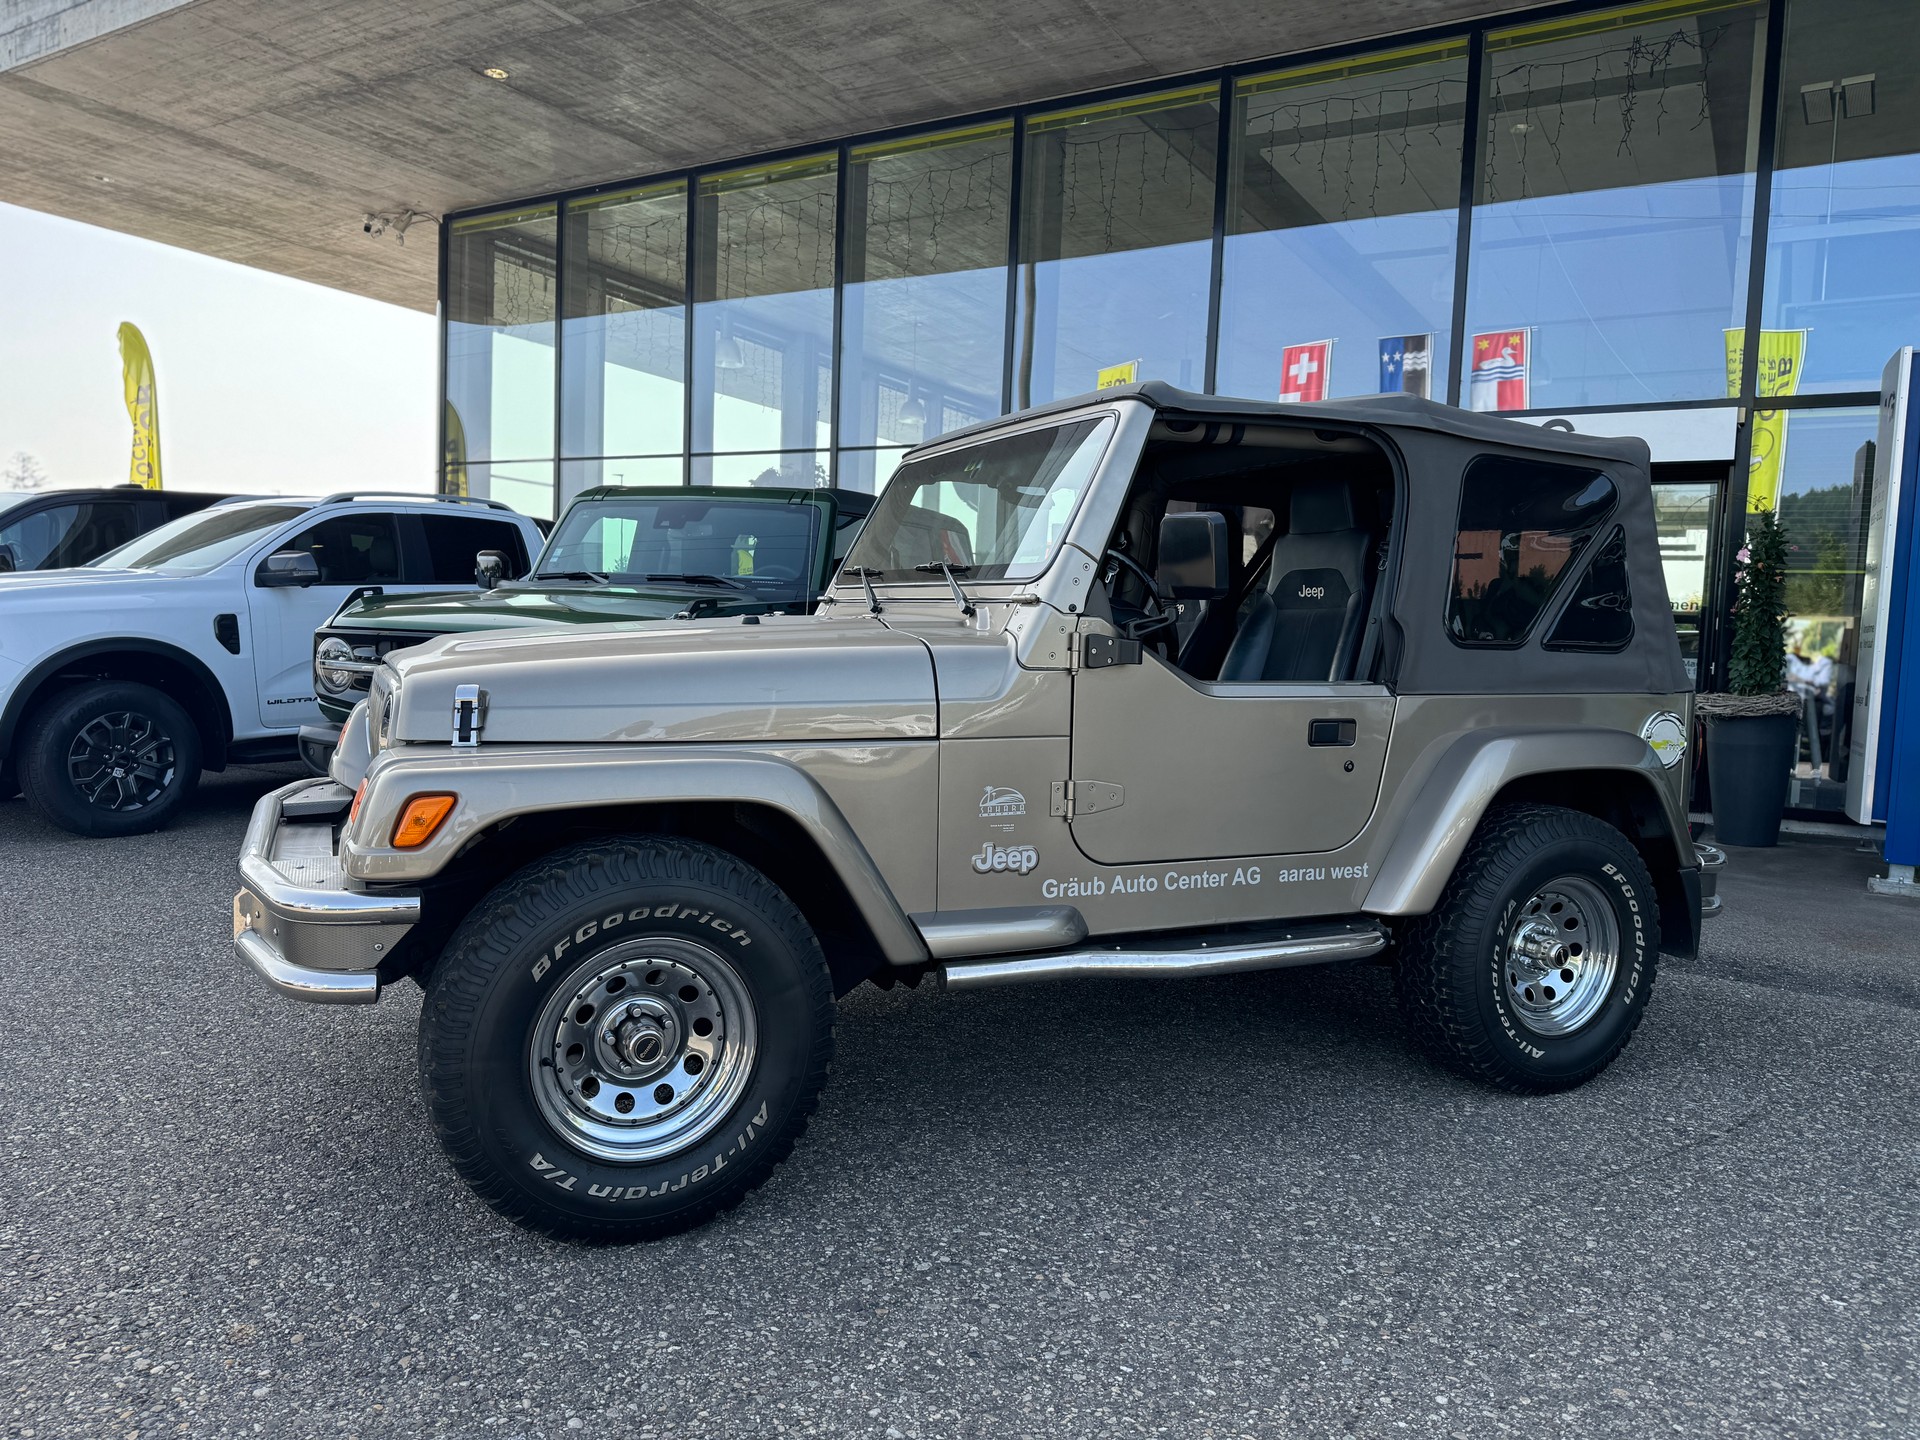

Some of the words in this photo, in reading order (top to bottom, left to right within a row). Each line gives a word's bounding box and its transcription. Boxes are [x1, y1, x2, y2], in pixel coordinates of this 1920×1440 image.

[1298, 584, 1325, 600] Jeep
[267, 696, 318, 705] WILDTRA
[973, 844, 1039, 873] Jeep
[1042, 878, 1105, 899] Gräub
[1110, 874, 1158, 895] Auto
[1164, 871, 1228, 891] Center
[1232, 866, 1261, 886] AG
[1278, 866, 1325, 883] aarau
[1331, 863, 1369, 880] west
[1496, 899, 1518, 938] T/A
[1601, 863, 1647, 1006] BFGoodrich
[530, 903, 753, 984] BFGoodrich
[1490, 944, 1546, 1060] All-Terrain
[587, 1099, 770, 1203] All-Terrain
[527, 1152, 582, 1191] T/A
